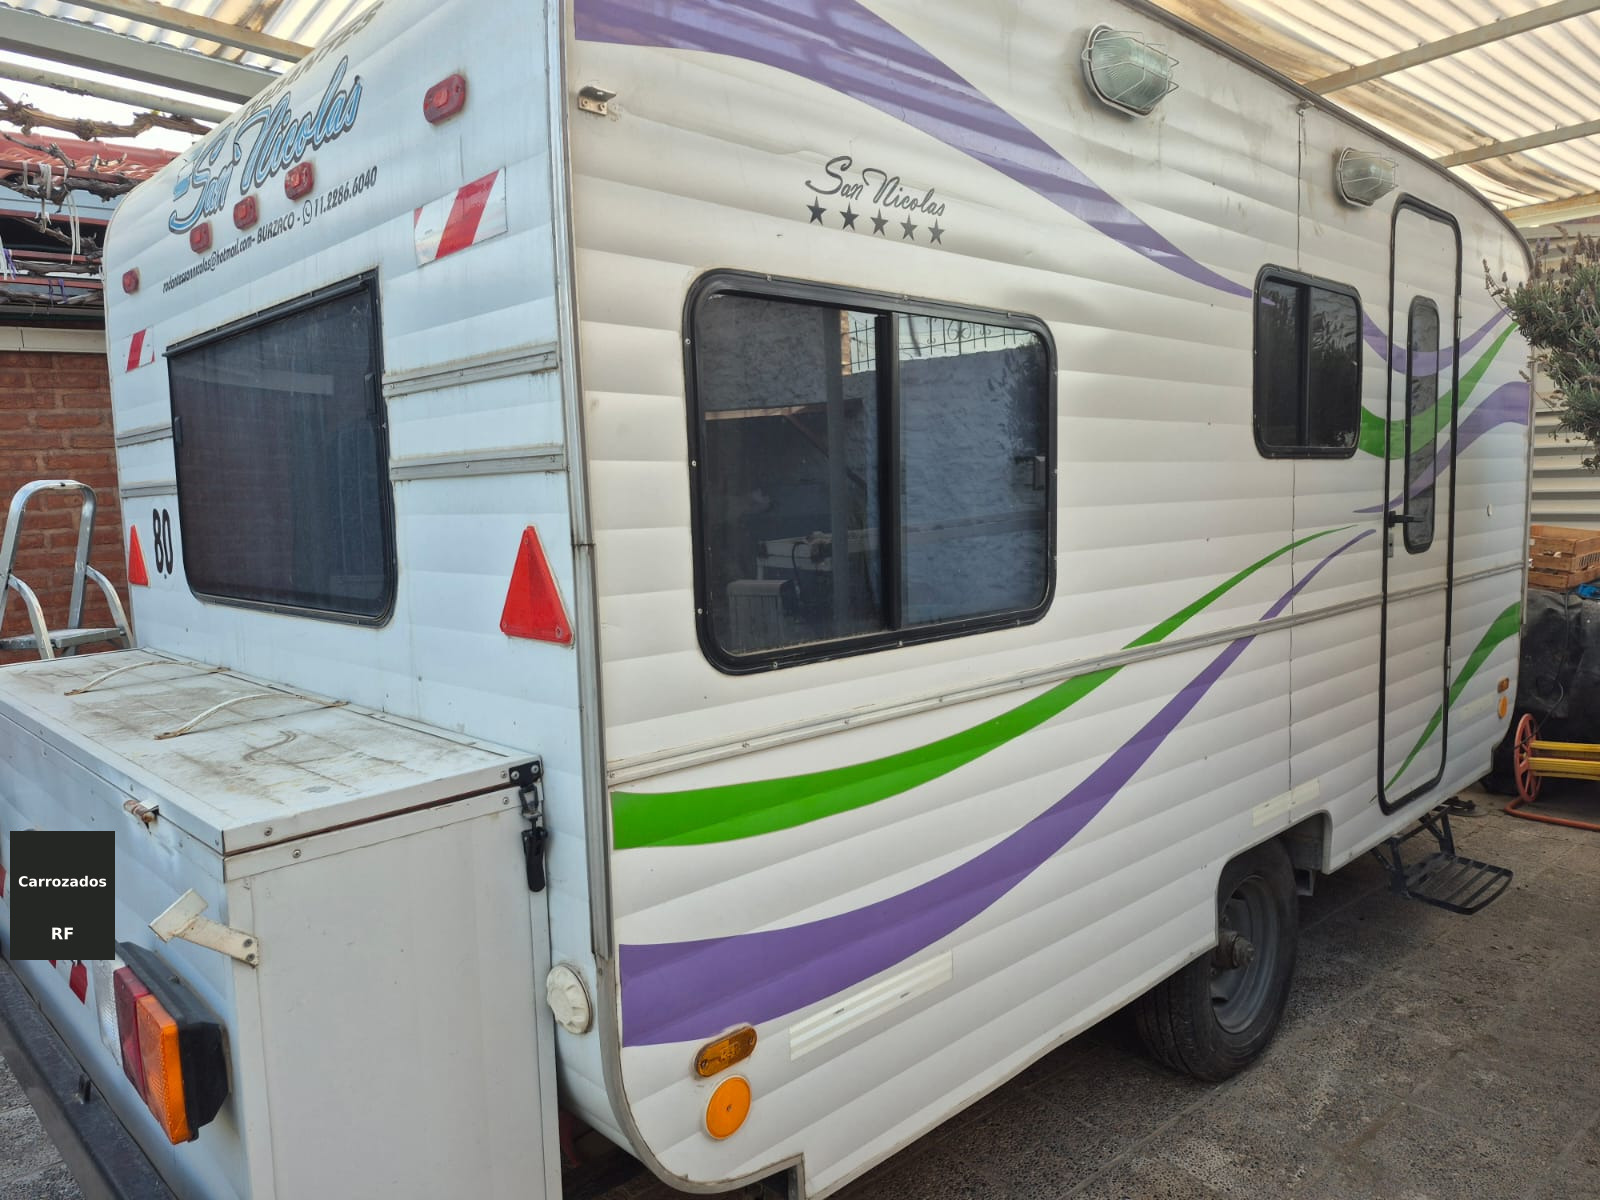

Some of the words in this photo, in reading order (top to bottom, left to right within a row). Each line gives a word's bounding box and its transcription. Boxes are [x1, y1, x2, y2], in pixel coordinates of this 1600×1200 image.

[168, 121, 235, 234] San
[232, 54, 364, 196] Nicolas
[257, 211, 295, 244] BURZACO
[314, 165, 378, 217] 11.2286.6040
[805, 155, 864, 200] San
[862, 167, 946, 217] Nicolas
[152, 508, 174, 575] 80
